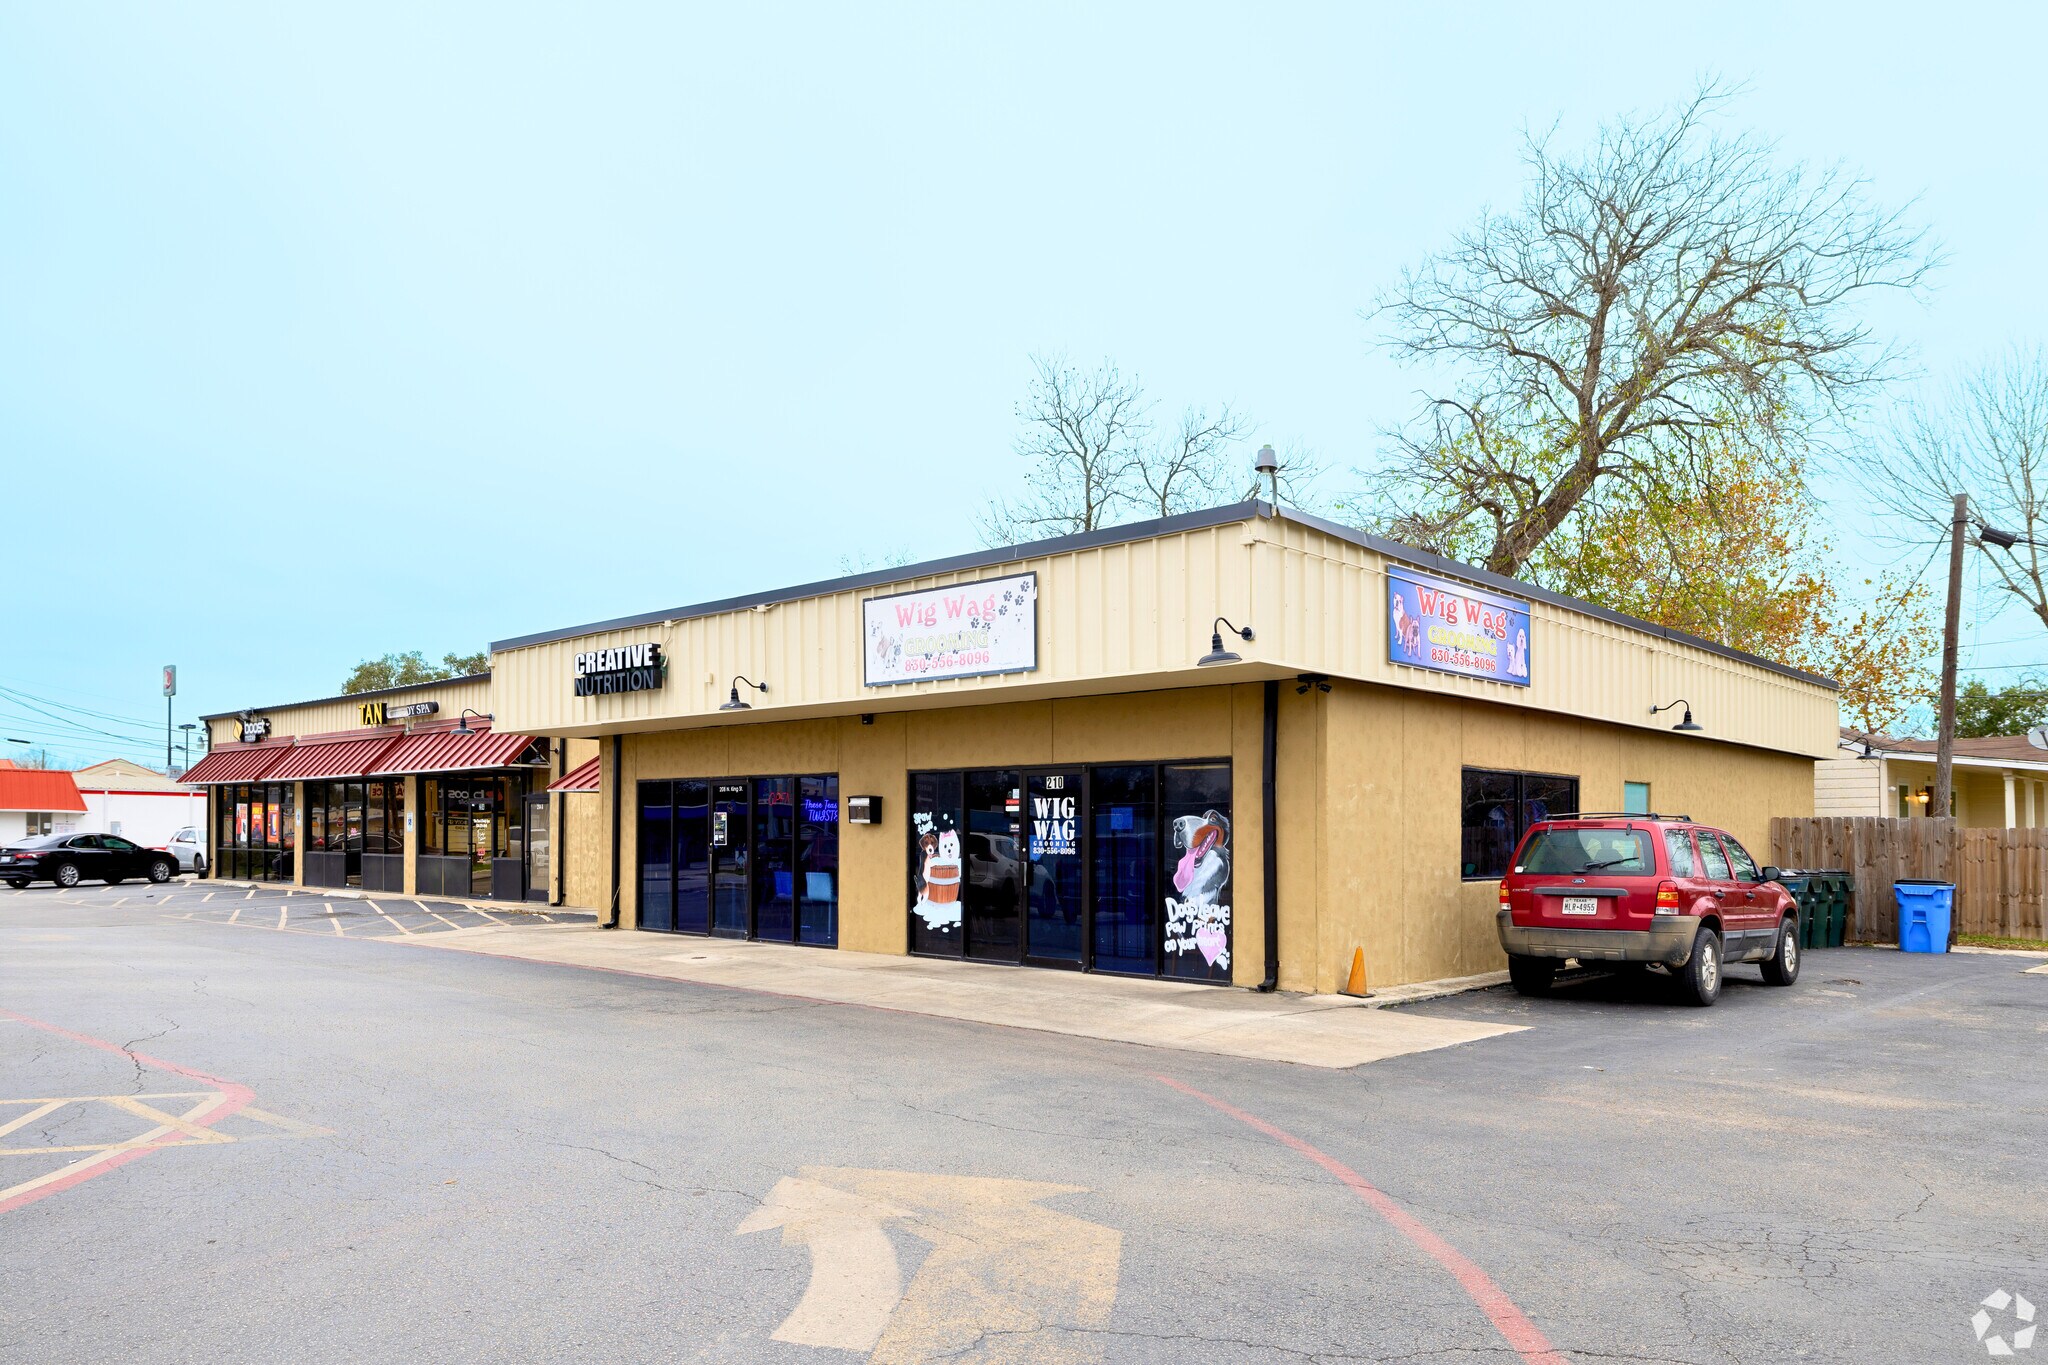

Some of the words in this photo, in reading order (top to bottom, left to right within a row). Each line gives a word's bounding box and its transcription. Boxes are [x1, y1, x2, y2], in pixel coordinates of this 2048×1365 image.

[894, 601, 937, 628] Wig
[943, 593, 997, 622] Wag
[1416, 585, 1458, 625] Wig
[1462, 597, 1507, 641] Wag
[904, 629, 989, 657] GROOMING
[1427, 625, 1498, 657] GROOMING
[574, 643, 655, 675] CREATIVE
[904, 651, 990, 672] 830-556-8096
[1431, 647, 1496, 672] 830-556-8096
[574, 669, 656, 696] NUTRITION
[358, 702, 384, 725] TAN
[416, 703, 431, 715] SPA
[244, 719, 266, 735] boost
[1047, 776, 1063, 789] 210
[805, 799, 823, 809] These
[1033, 796, 1075, 820] WIG
[1033, 819, 1075, 841] WAG
[1033, 847, 1076, 855] 830-556-8096
[1164, 938, 1177, 953] on
